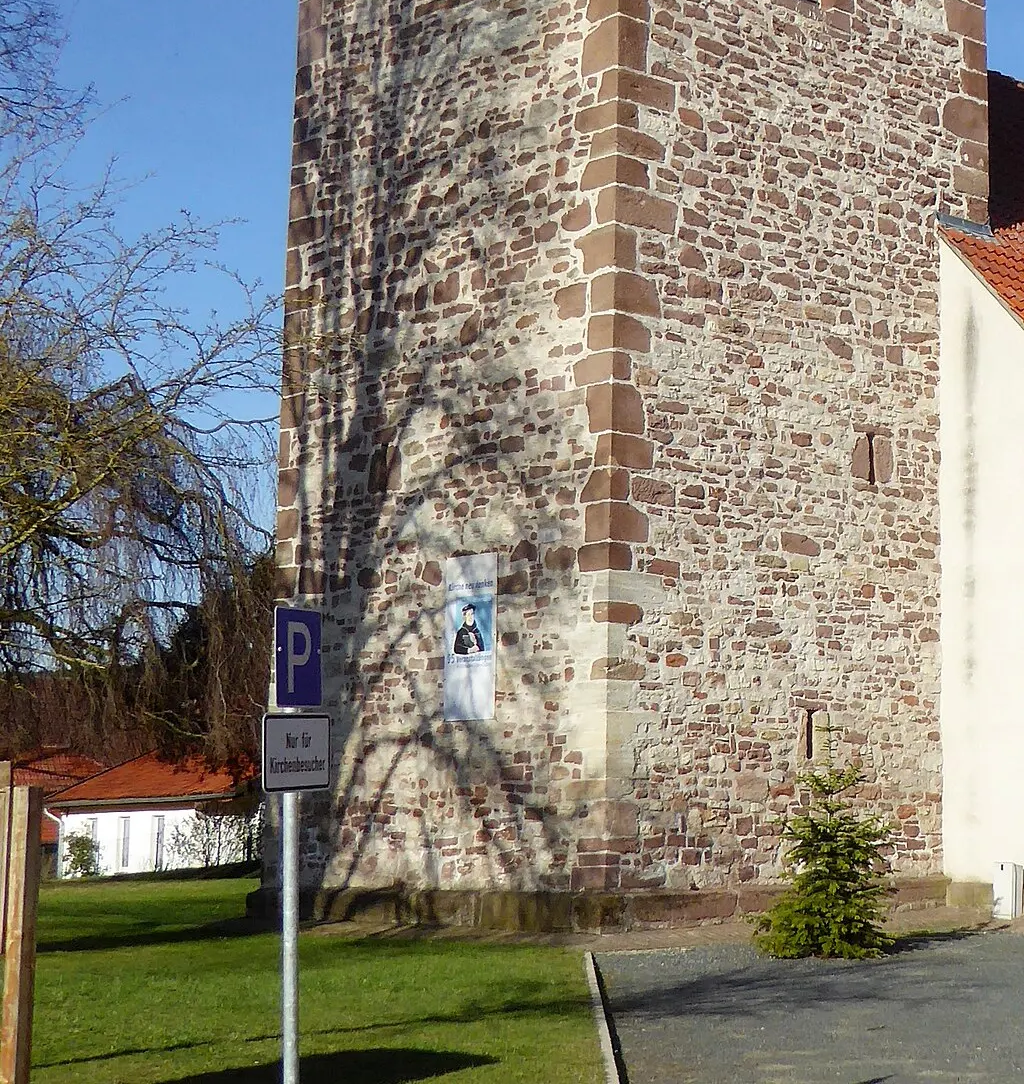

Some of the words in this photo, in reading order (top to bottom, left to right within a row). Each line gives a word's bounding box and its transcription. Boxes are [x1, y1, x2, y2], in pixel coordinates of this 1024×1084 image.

[287, 621, 311, 693] P
[286, 732, 298, 748] Nur
[302, 731, 312, 748] für
[270, 756, 325, 773] Kirchenbesucher
